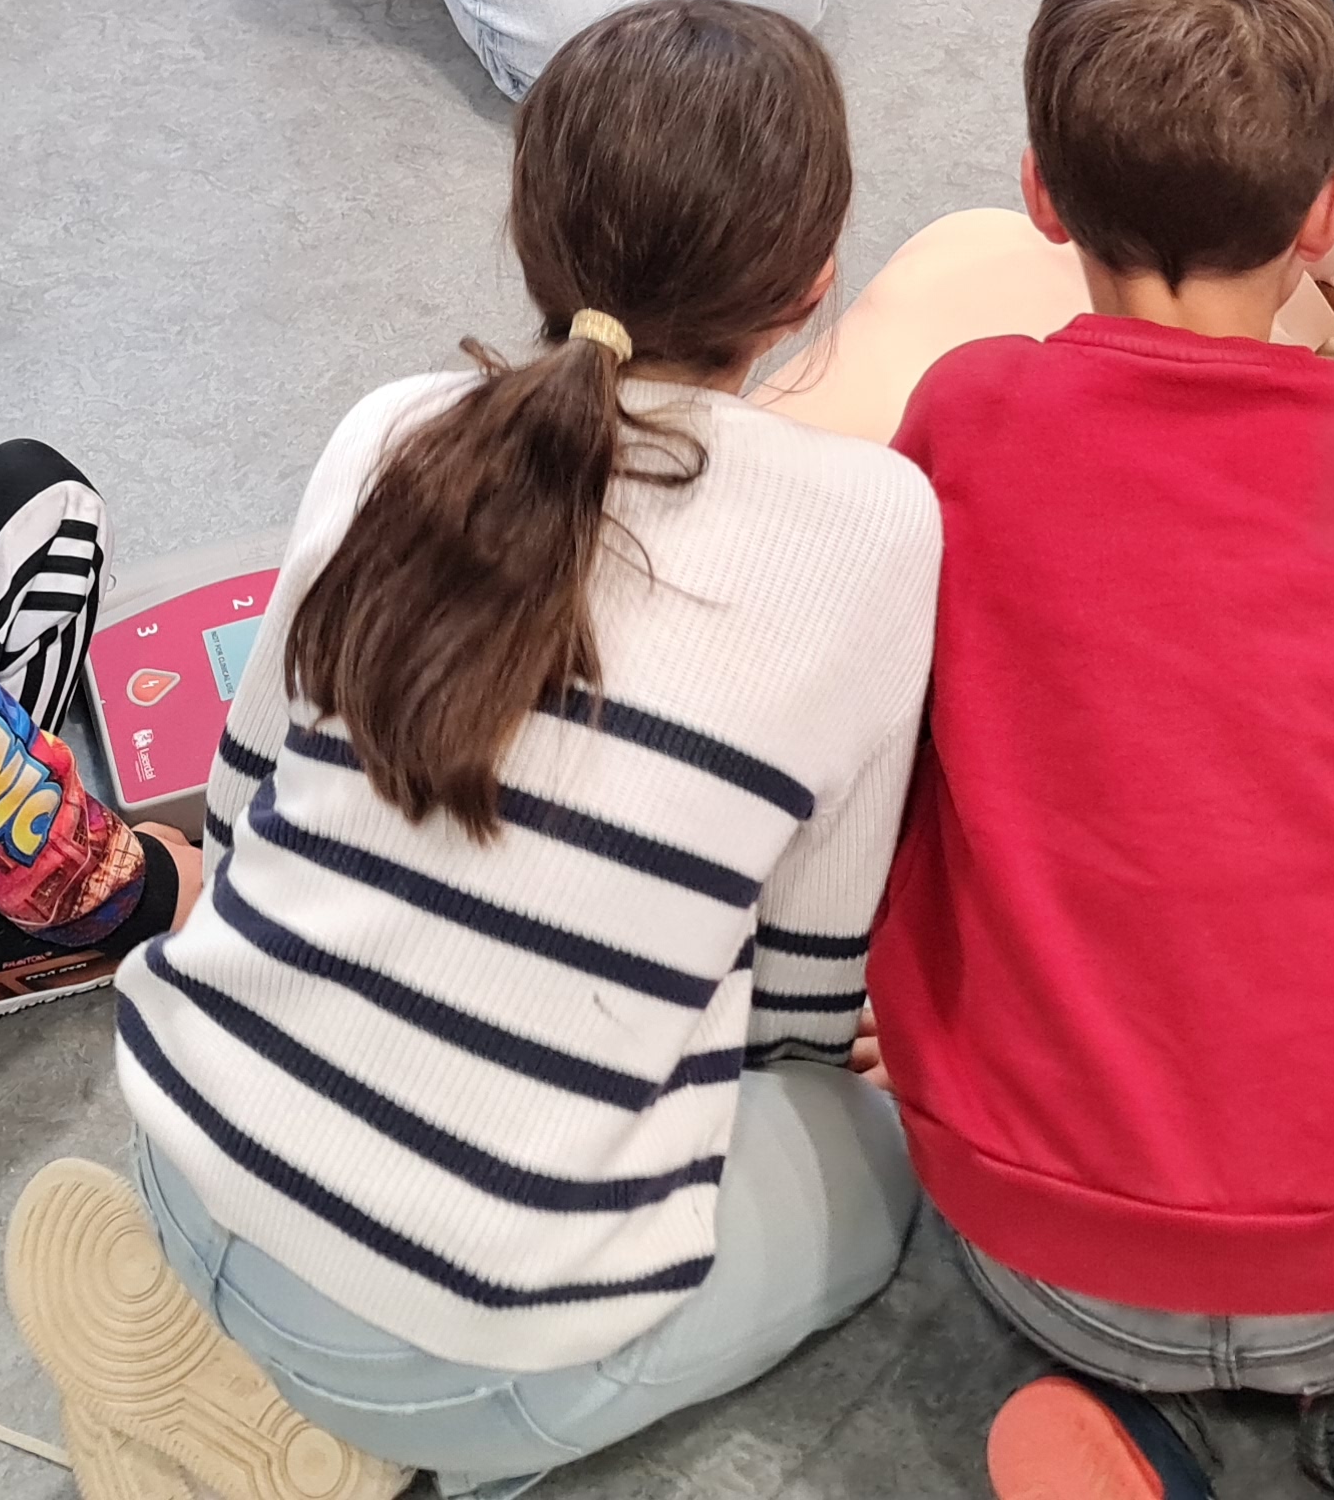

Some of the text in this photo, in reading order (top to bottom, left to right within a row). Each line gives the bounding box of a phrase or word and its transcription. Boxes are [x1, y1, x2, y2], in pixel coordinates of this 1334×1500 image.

[232, 595, 254, 610] 2
[136, 622, 158, 637] 3
[210, 630, 235, 695] NOT FOR CLINICAL USE
[139, 747, 156, 781] Laerdal
